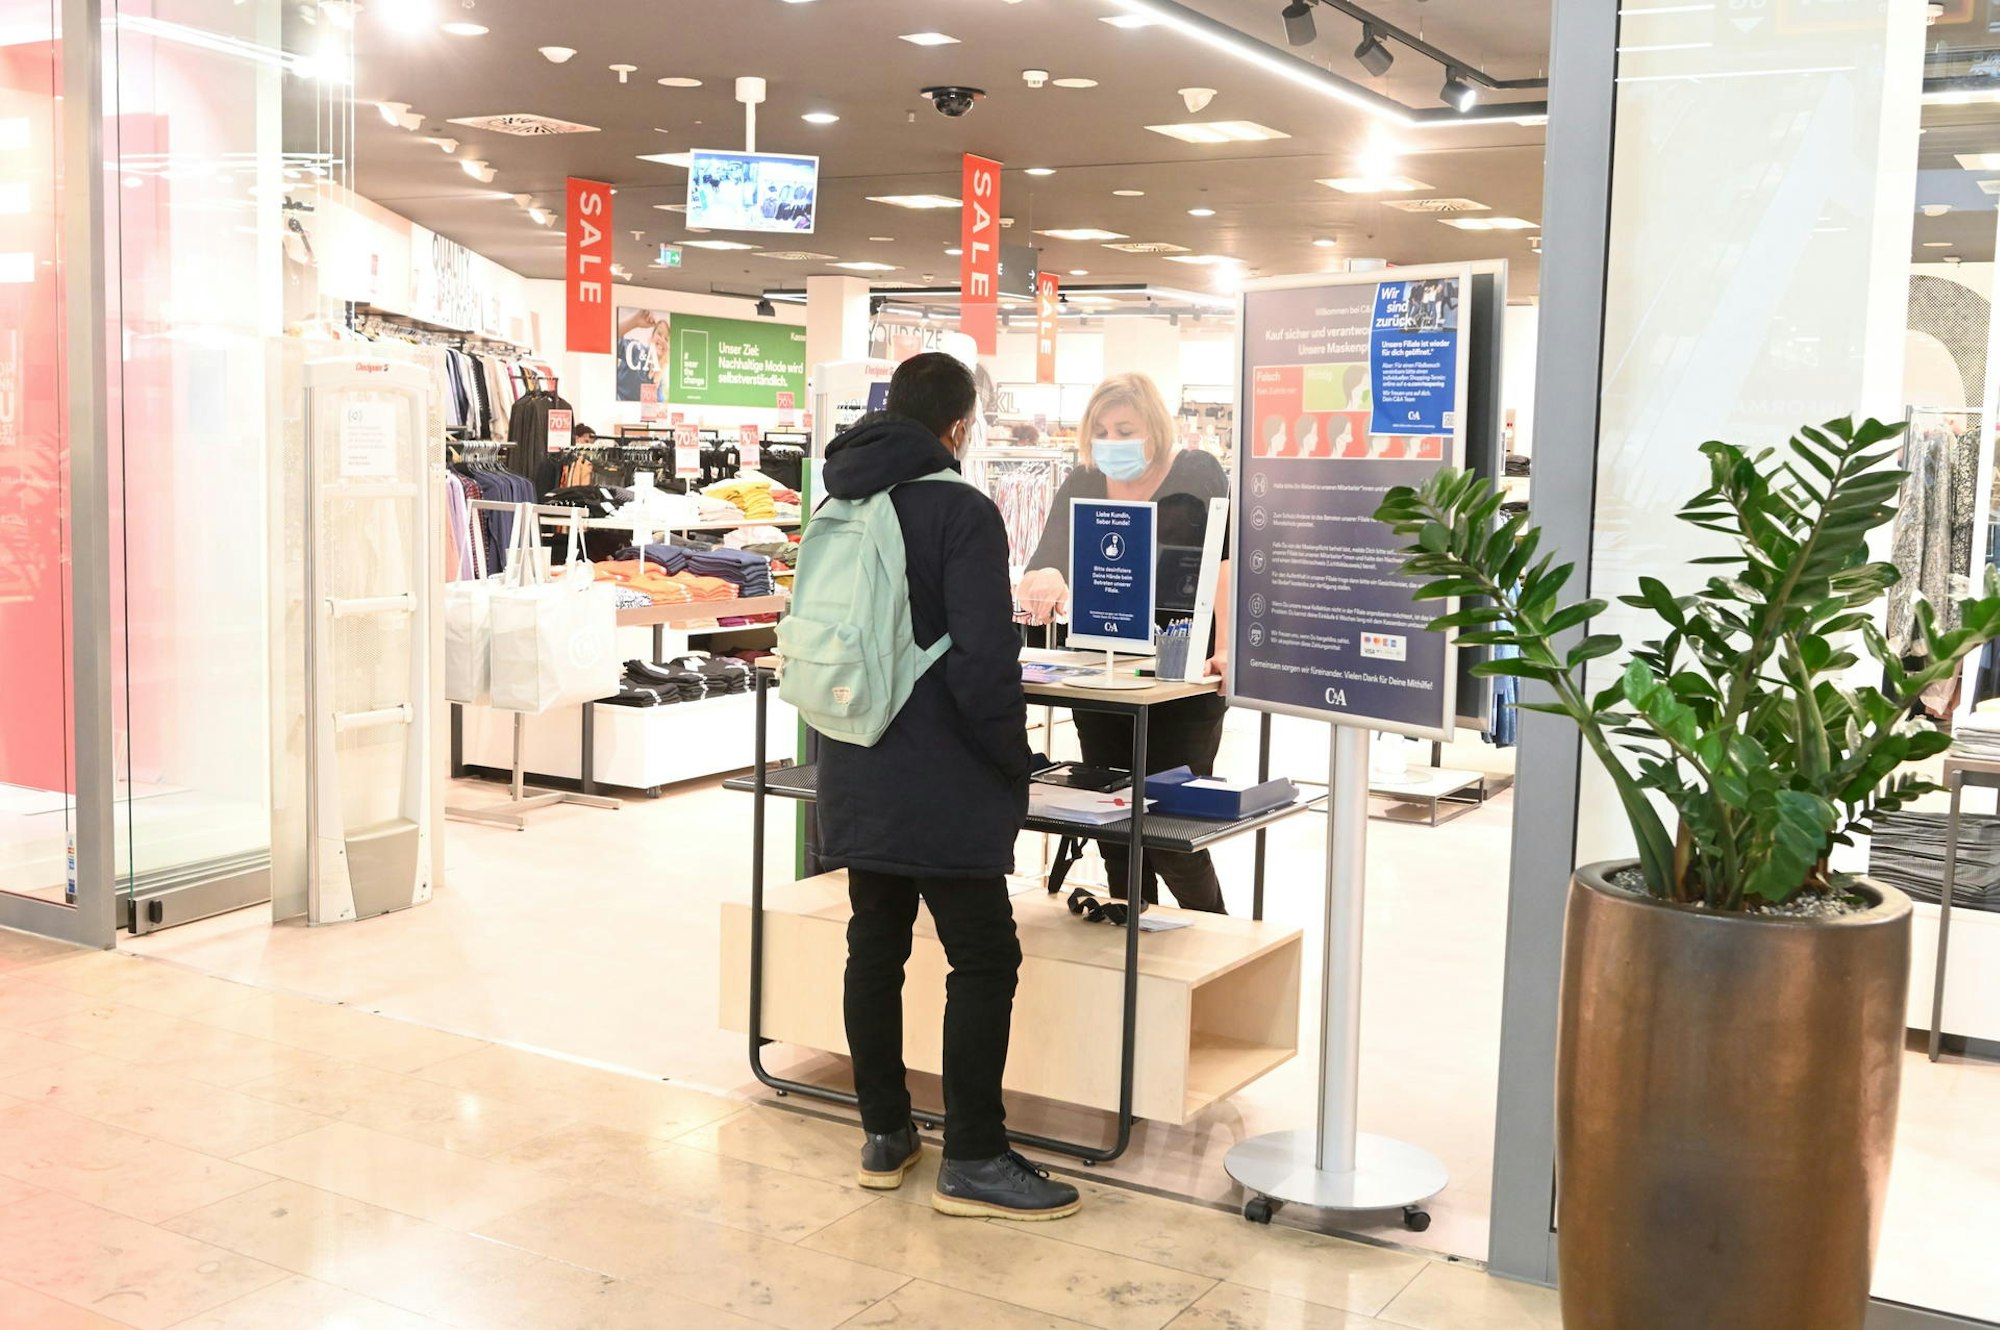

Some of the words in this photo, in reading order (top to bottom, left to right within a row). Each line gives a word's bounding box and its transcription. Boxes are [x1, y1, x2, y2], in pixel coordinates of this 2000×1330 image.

[971, 168, 993, 297] SALE
[579, 191, 602, 304] SALE
[1381, 287, 1400, 300] Wir
[1386, 301, 1409, 313] sind
[1041, 280, 1053, 355] SALE
[1265, 328, 1284, 341] Kauf
[1285, 327, 1310, 340] sicher
[1311, 326, 1326, 338] und
[1327, 325, 1368, 337] verantwo
[718, 341, 742, 354] Unser
[743, 343, 760, 356] Ziel:
[1326, 341, 1368, 354] Maskenp
[1403, 339, 1421, 347] Filiale
[1421, 339, 1429, 347] ist
[1430, 339, 1450, 347] wieder
[625, 341, 661, 371] C&A
[1381, 348, 1391, 356] für
[1391, 348, 1405, 356] dich
[718, 356, 764, 373] Nachhaltige
[764, 360, 787, 373] Mode
[787, 361, 804, 374] wird
[718, 371, 788, 387] selbstverständlich.
[677, 430, 698, 446] 70%
[1111, 511, 1130, 519] Kundin,
[1250, 659, 1282, 670] Gemeinsam
[1282, 662, 1300, 673] sorgen
[1301, 665, 1310, 674] wir
[1310, 666, 1343, 678] füreinander.
[1344, 670, 1362, 680] Vielen
[1363, 672, 1378, 682] Dank
[1379, 674, 1388, 683] für
[1388, 675, 1406, 686] Deine
[1407, 677, 1433, 689] Mithilfe!
[1325, 687, 1347, 706] C&A
